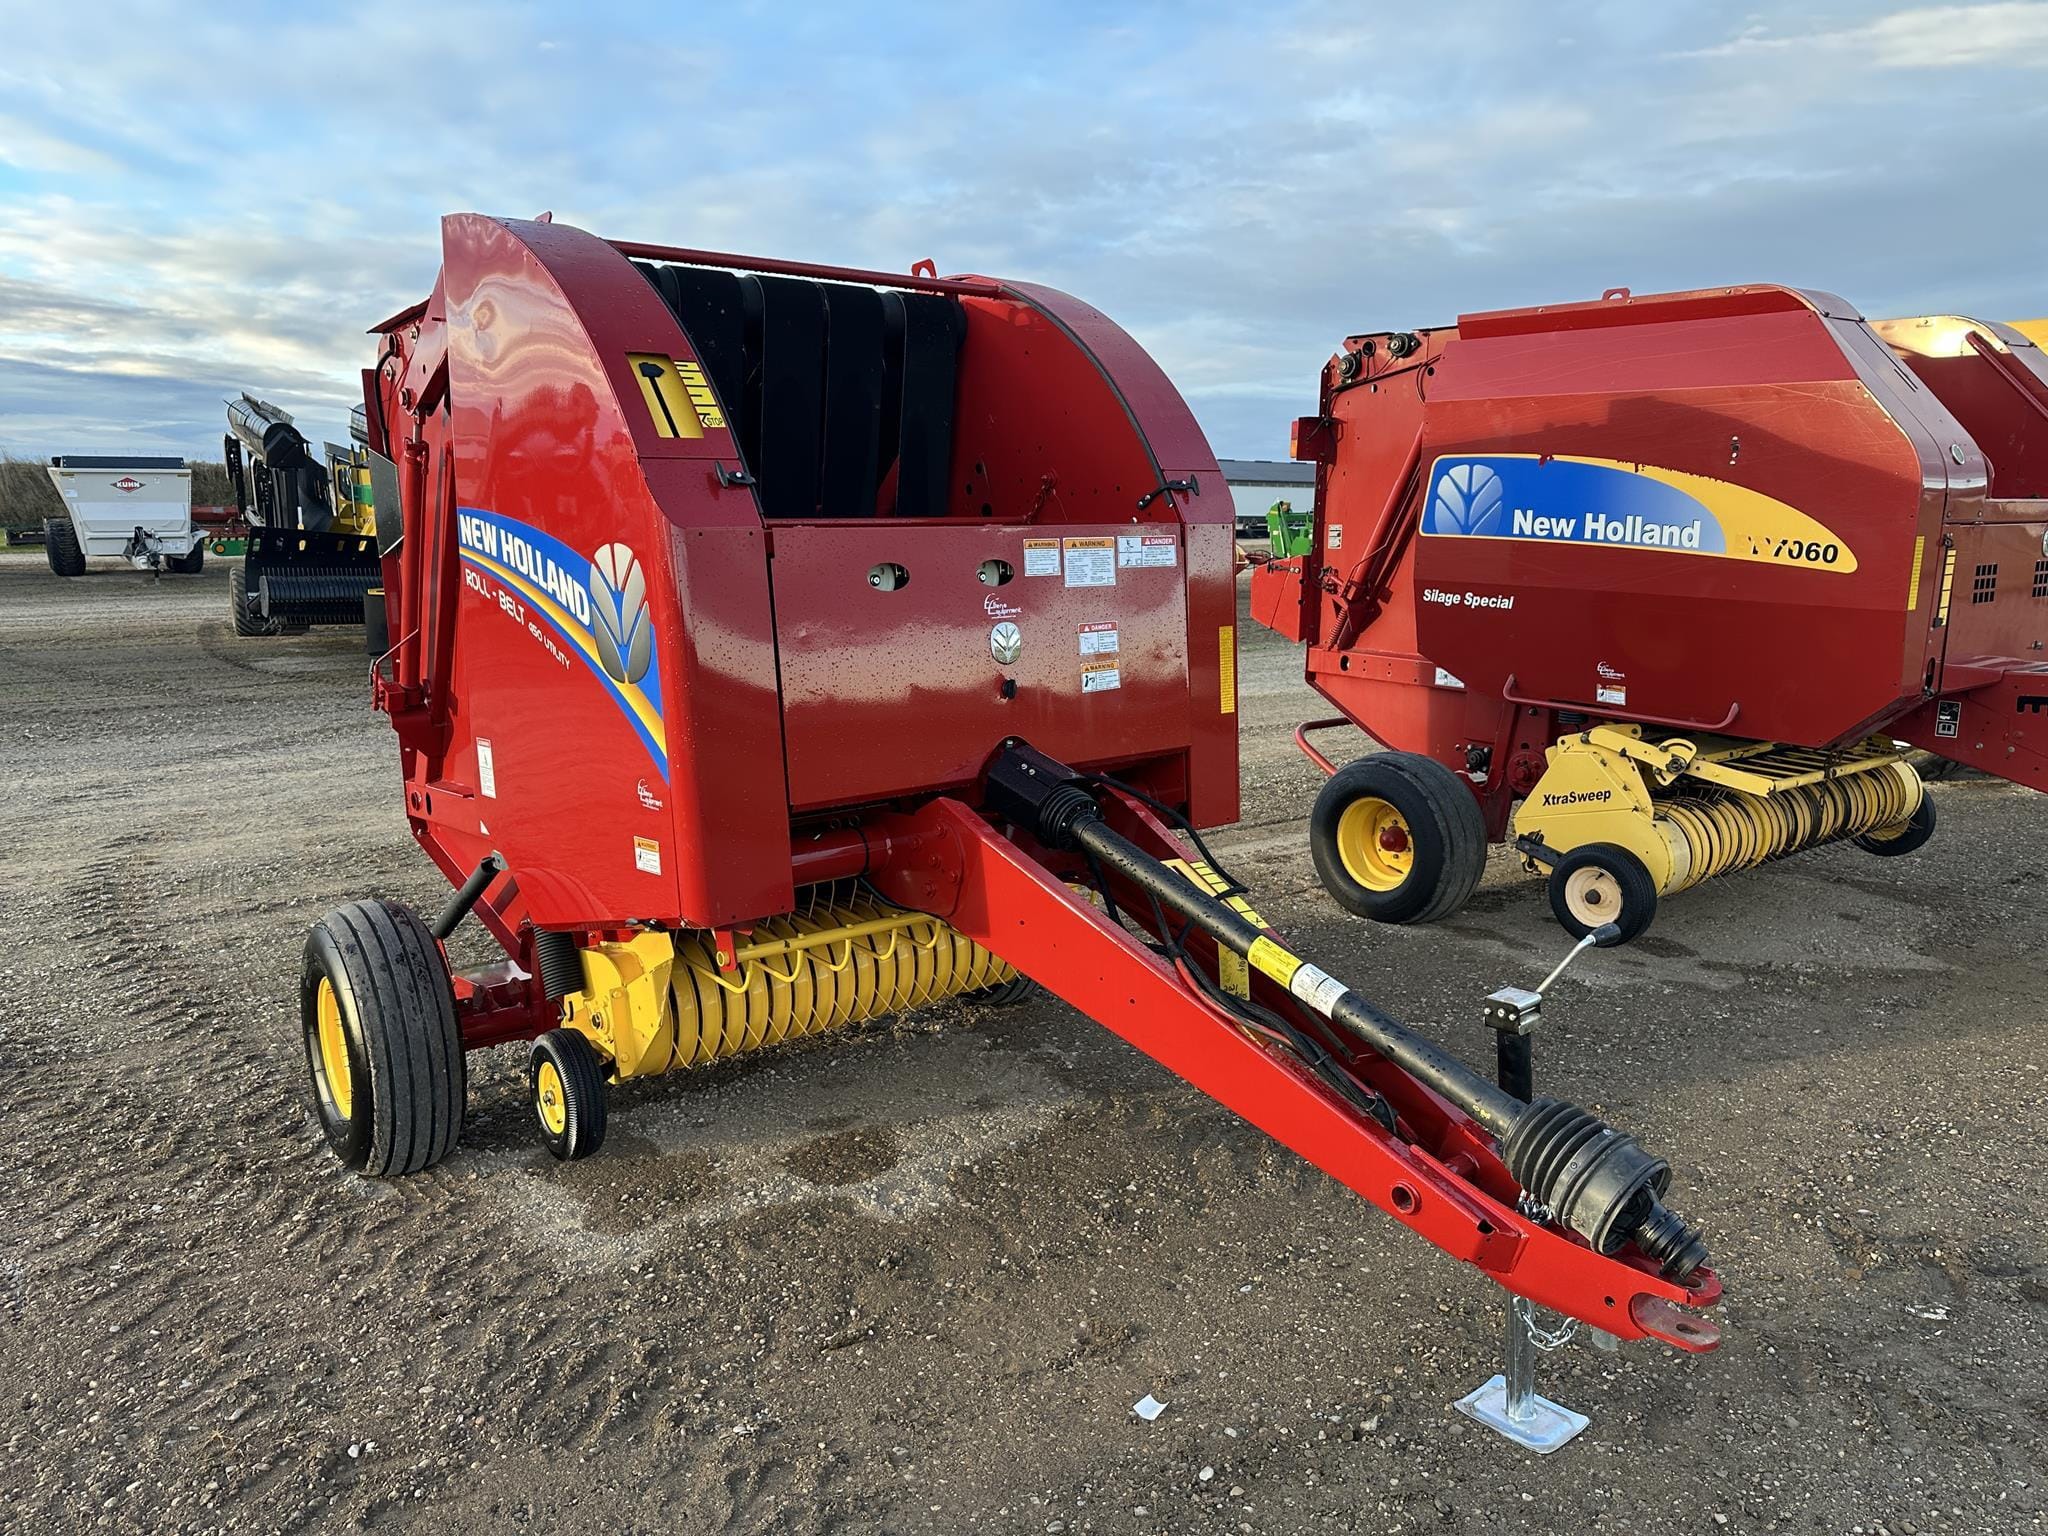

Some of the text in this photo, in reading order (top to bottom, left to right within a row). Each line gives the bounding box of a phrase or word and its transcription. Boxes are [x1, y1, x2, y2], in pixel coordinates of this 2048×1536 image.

[707, 417, 723, 426] STOP
[1512, 509, 1701, 548] New Holland
[459, 514, 590, 626] NEW HOLLAND
[1423, 588, 1514, 610] Silage Special
[465, 568, 491, 599] ROLL
[499, 589, 525, 625] BELT
[543, 636, 571, 670] UTILITY
[1091, 623, 1112, 631] DANGER
[1090, 662, 1115, 670] WARNING
[1542, 790, 1611, 807] XtraSweep
